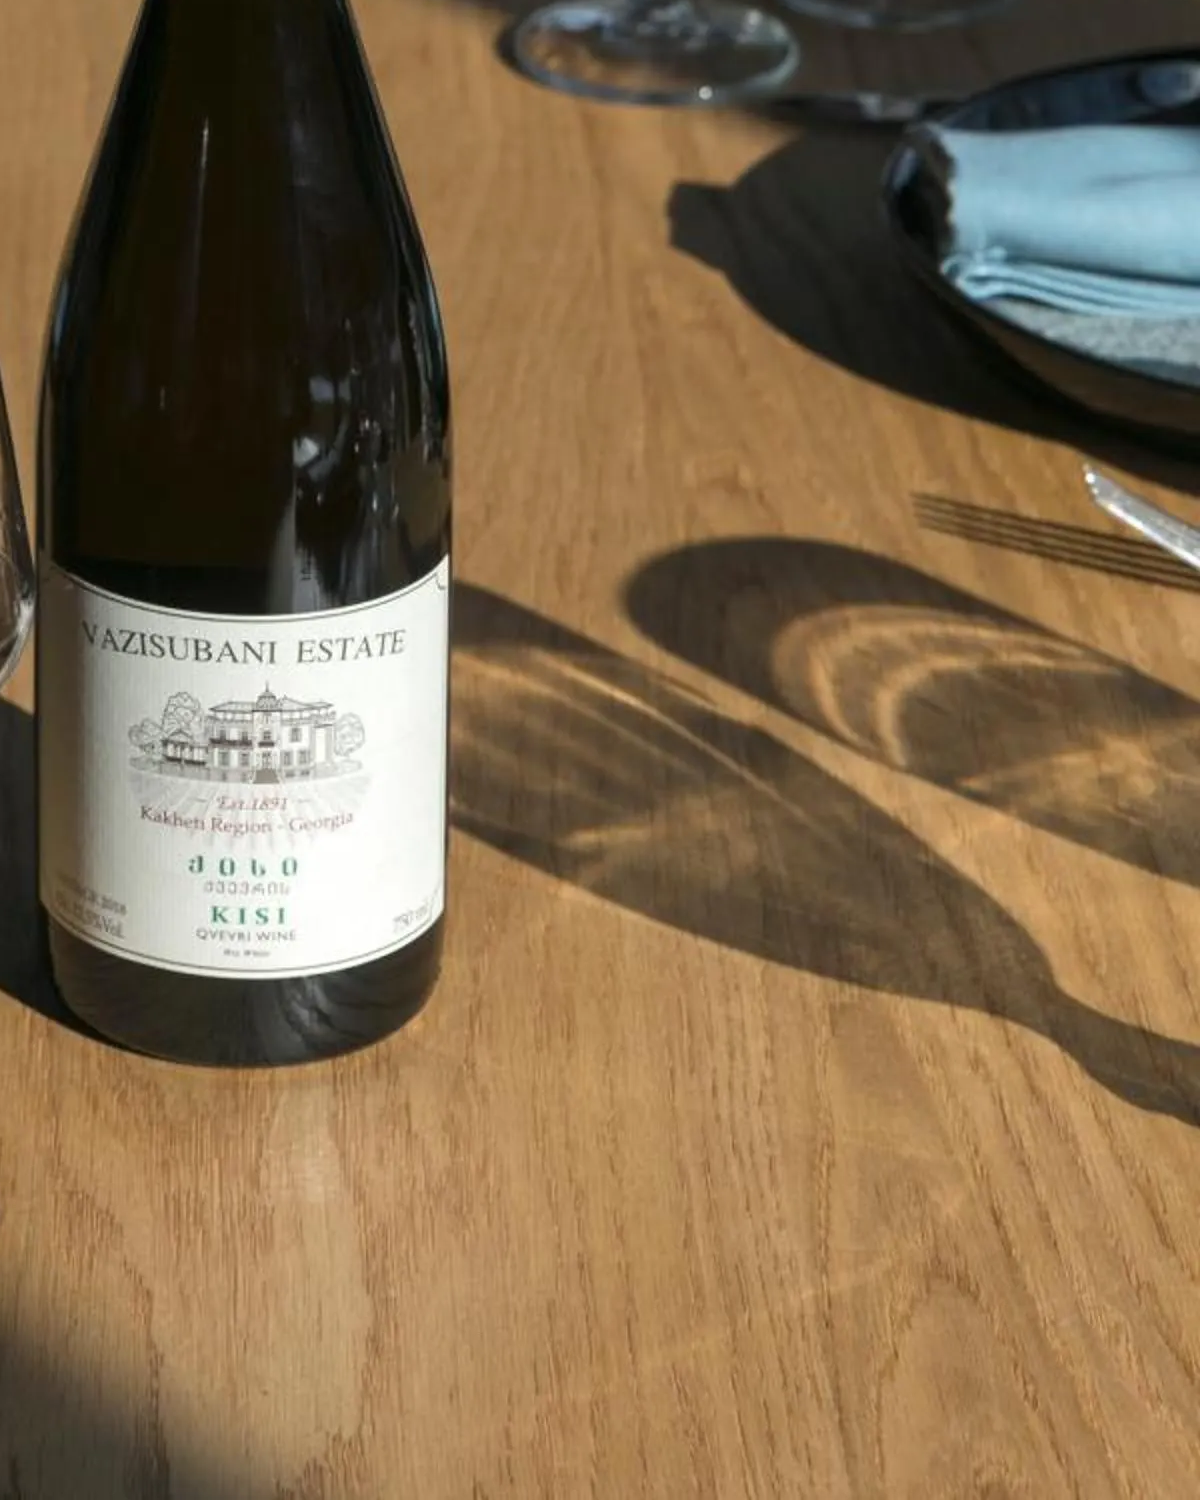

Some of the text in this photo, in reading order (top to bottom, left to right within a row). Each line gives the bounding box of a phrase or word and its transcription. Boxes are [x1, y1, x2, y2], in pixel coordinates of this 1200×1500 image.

[81, 619, 407, 665] VAZISUBANI ESTATE
[211, 816, 272, 837] Region
[288, 811, 353, 833] Georgia
[211, 905, 285, 925] KISI
[255, 929, 296, 941] WINE
